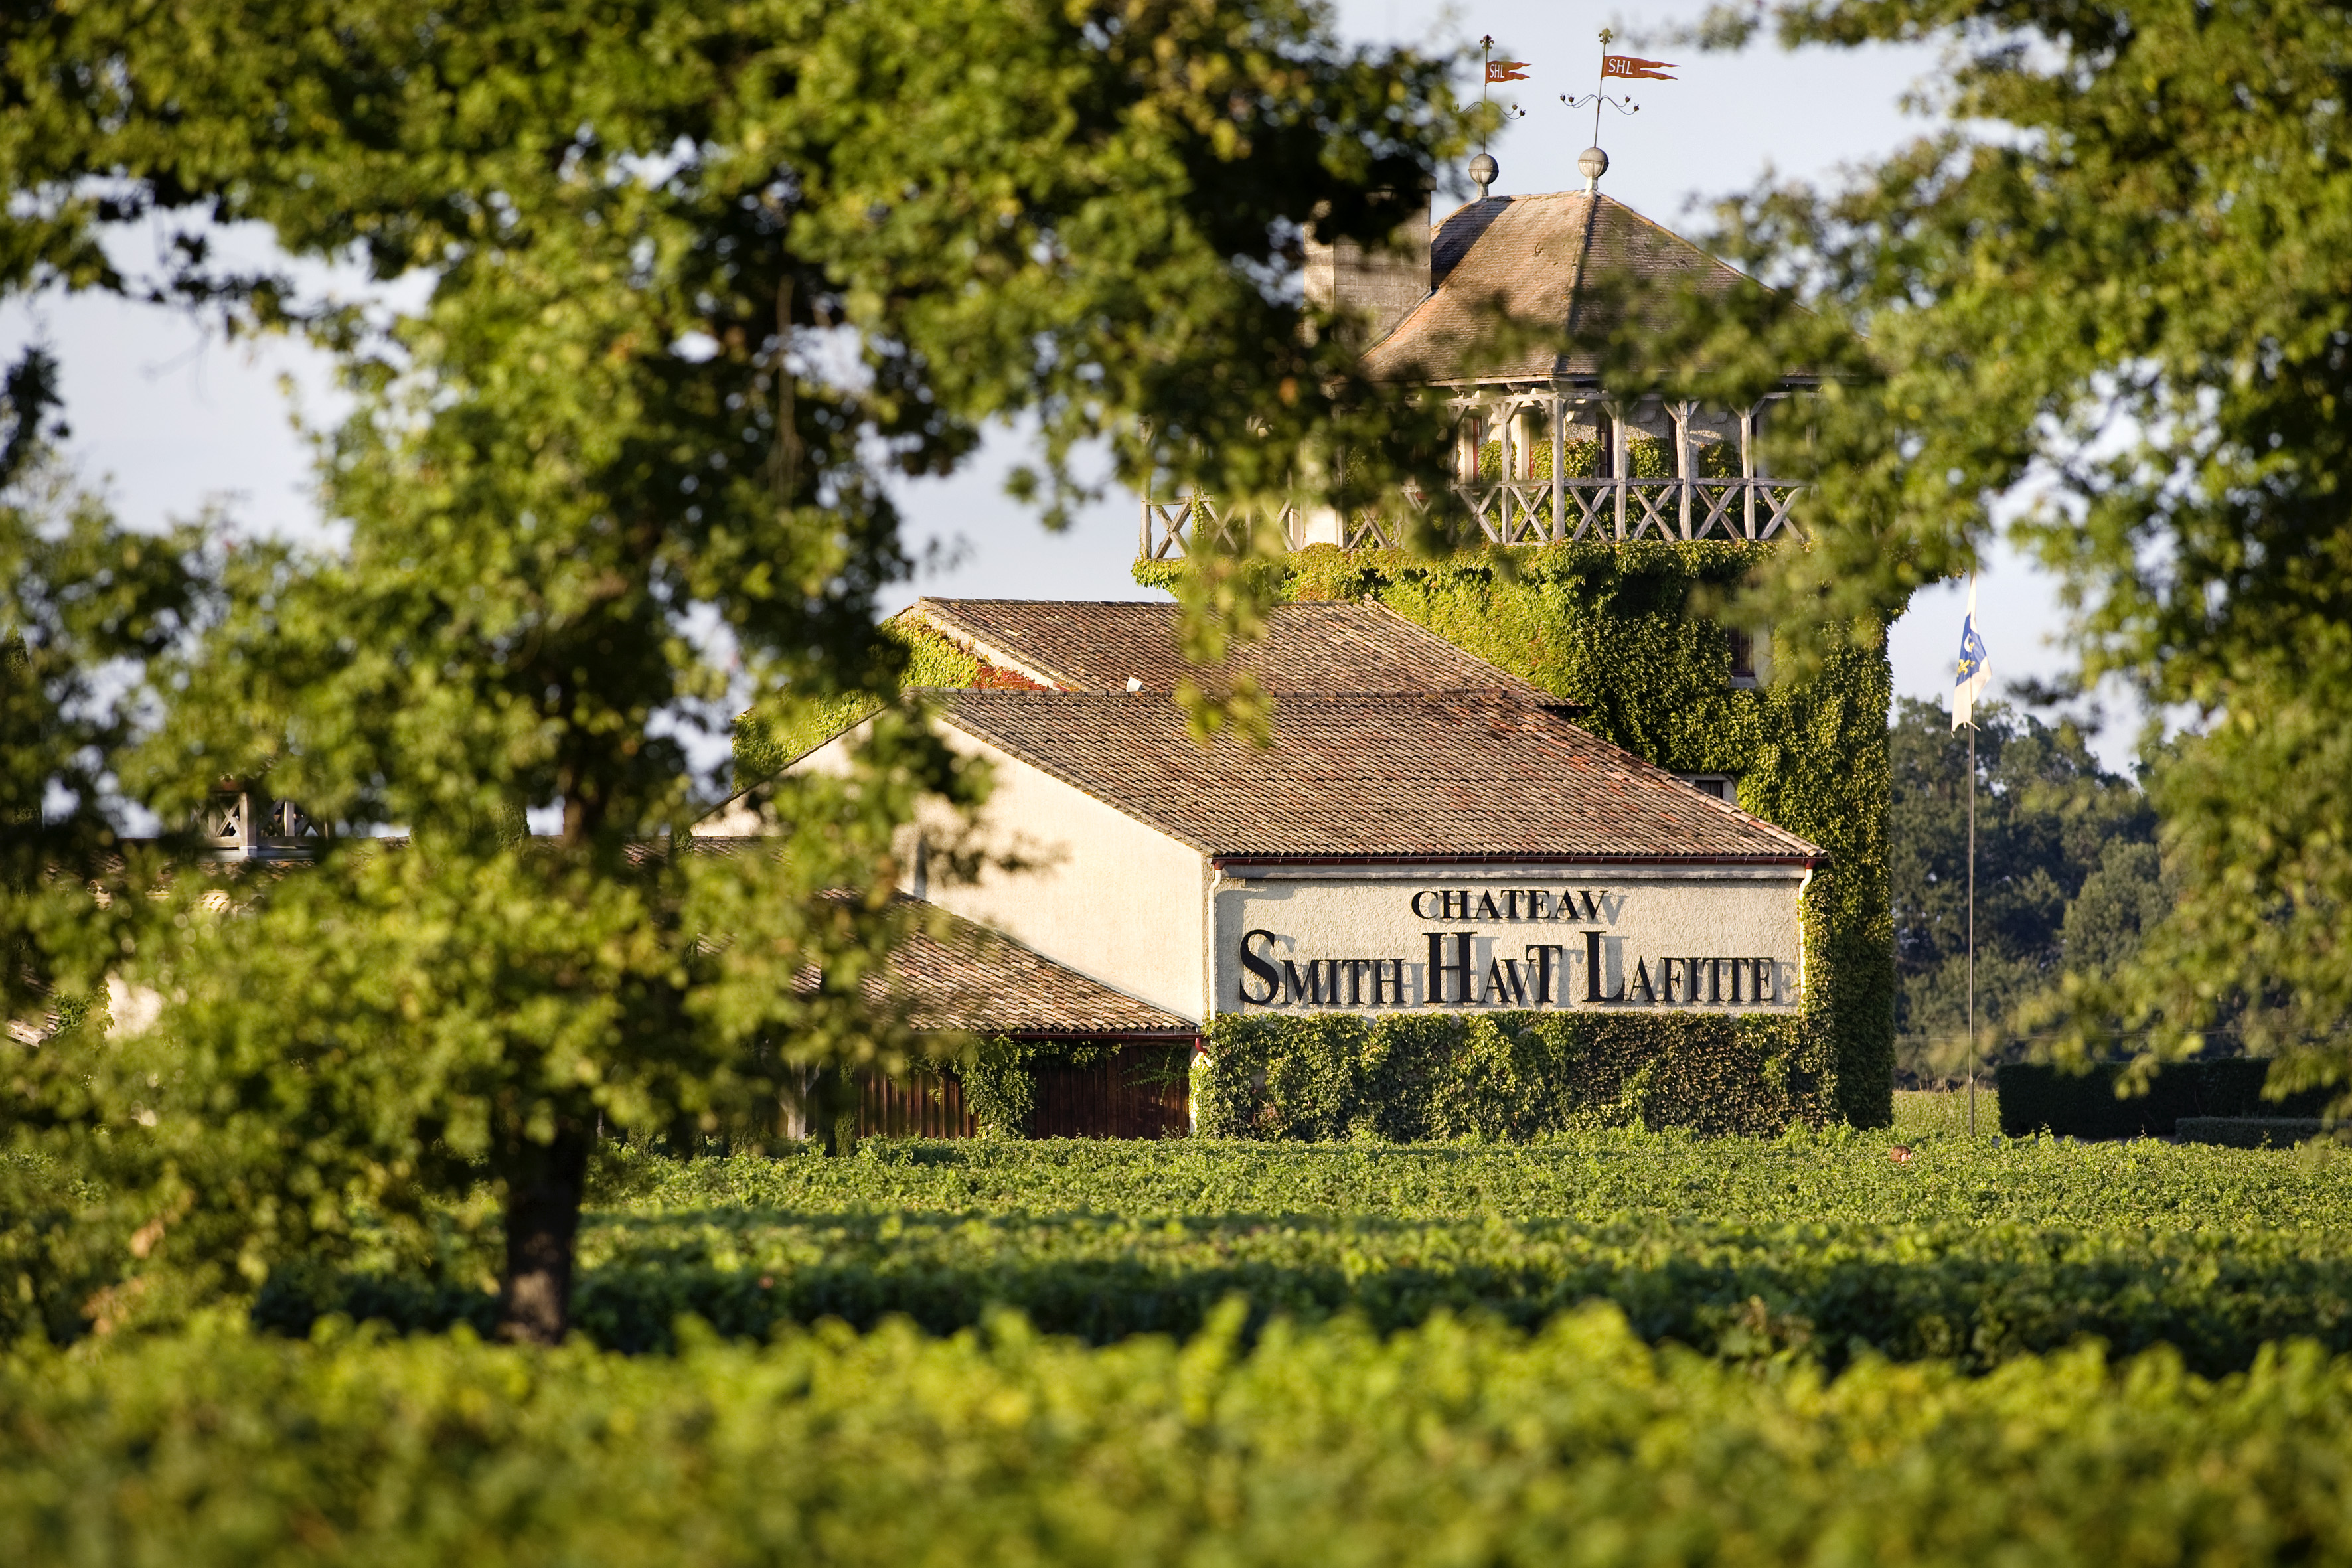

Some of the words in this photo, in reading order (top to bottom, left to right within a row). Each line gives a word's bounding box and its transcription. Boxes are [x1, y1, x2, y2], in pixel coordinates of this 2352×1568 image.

[1489, 64, 1505, 78] SHL
[1608, 58, 1633, 75] SHL
[1411, 889, 1608, 921] CHATEAV
[1239, 929, 1407, 1005] SMITH
[1579, 931, 1777, 1002] LAFITTE
